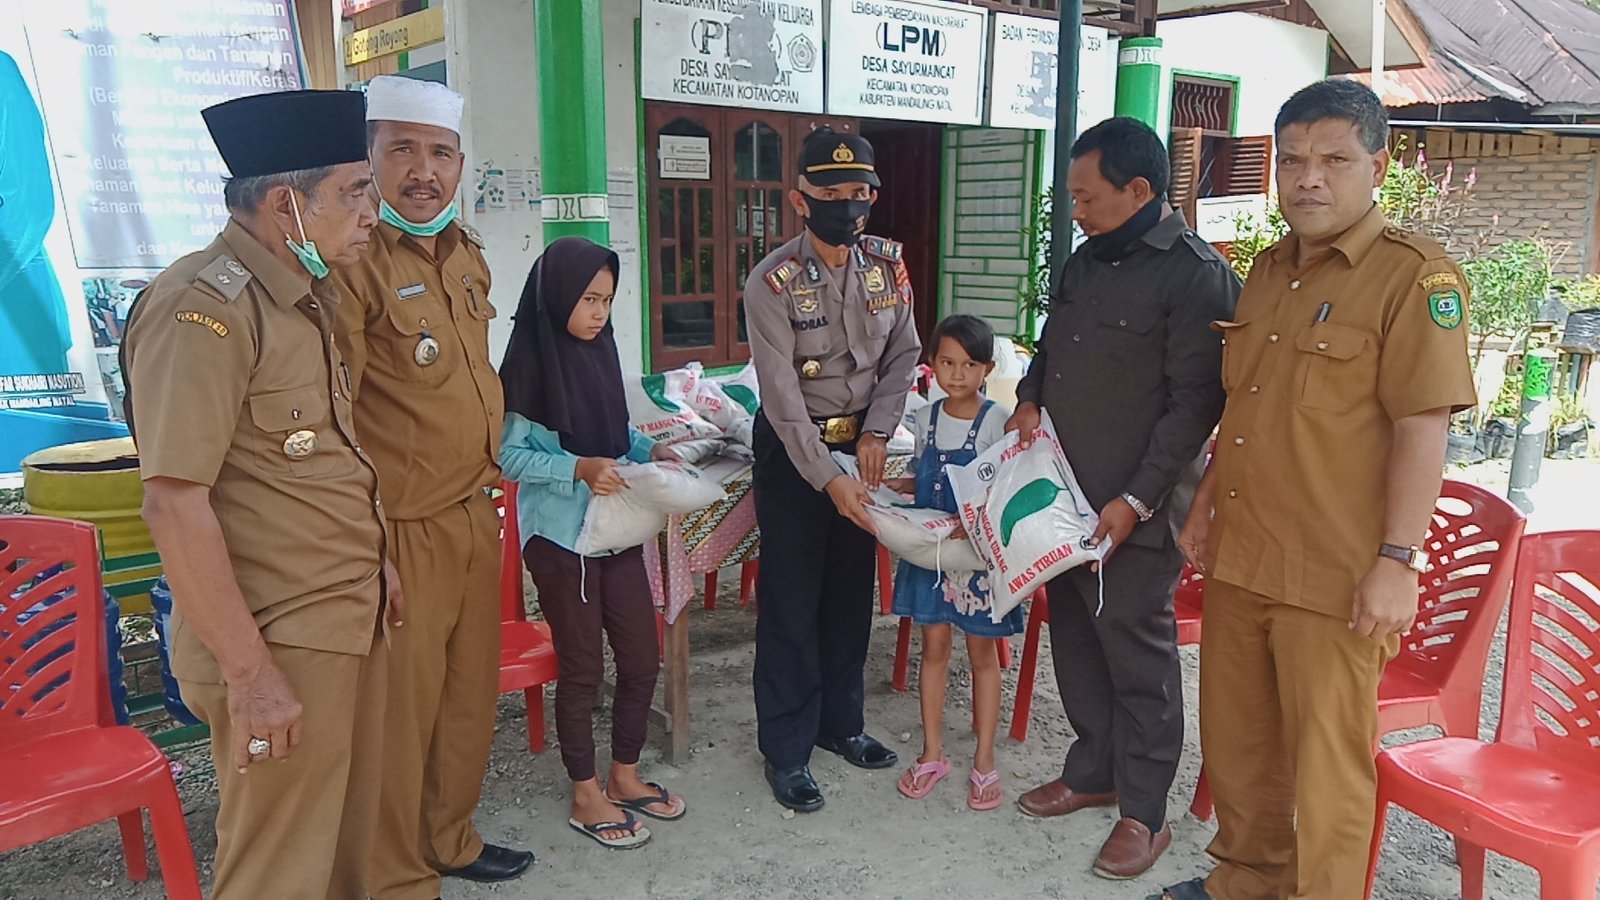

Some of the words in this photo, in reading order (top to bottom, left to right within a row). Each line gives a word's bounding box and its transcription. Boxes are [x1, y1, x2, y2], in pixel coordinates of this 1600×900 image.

[379, 27, 409, 50] Royong
[875, 22, 947, 57] (LPM)
[680, 58, 709, 79] DESA
[862, 55, 888, 72] DESA
[672, 78, 735, 99] KECAMATAN
[736, 86, 800, 105] KOTANOPAN
[990, 540, 1008, 574] UDANG
[1007, 567, 1035, 594] AWAS
[1033, 543, 1074, 573] TIRUAN
